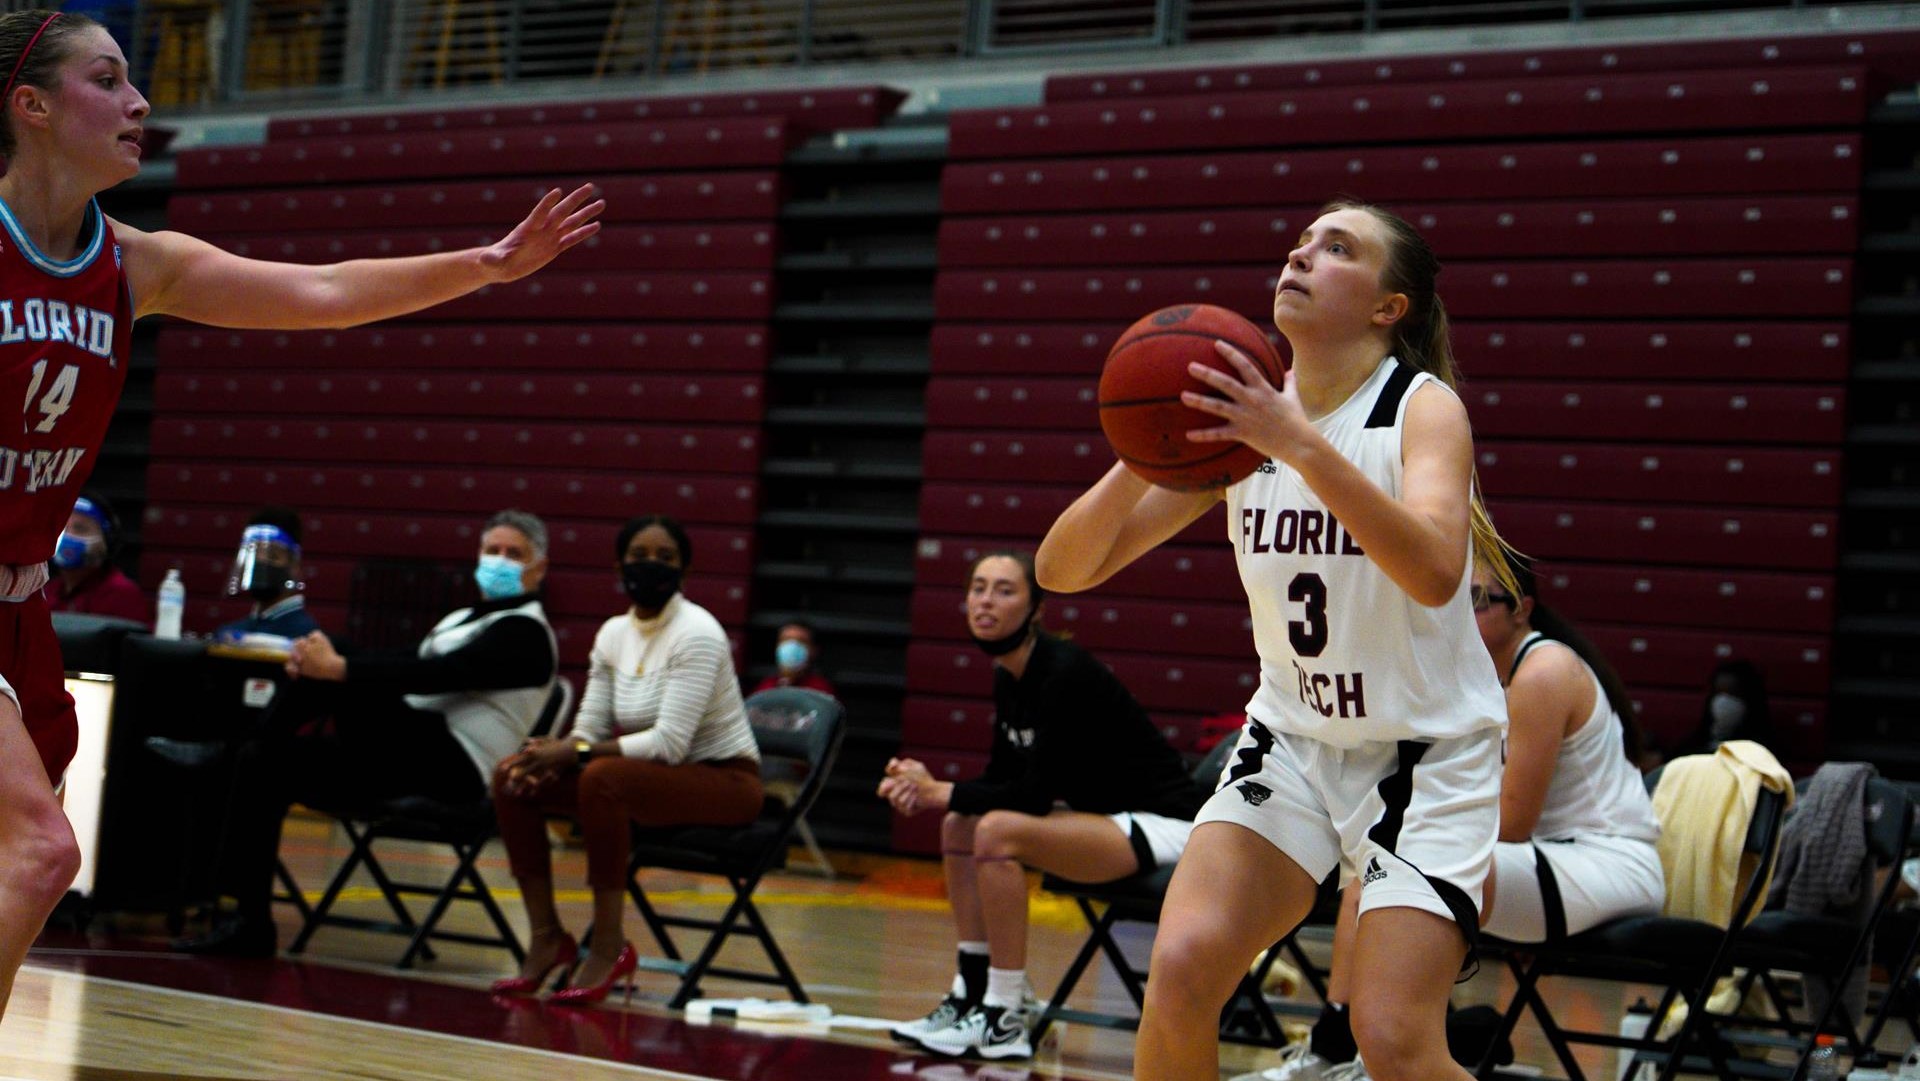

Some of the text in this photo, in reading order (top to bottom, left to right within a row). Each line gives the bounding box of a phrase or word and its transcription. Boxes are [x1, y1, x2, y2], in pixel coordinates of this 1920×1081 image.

[0, 298, 116, 366] LORID
[24, 358, 80, 434] 14
[1288, 572, 1328, 657] 3
[1292, 658, 1367, 718] TECH
